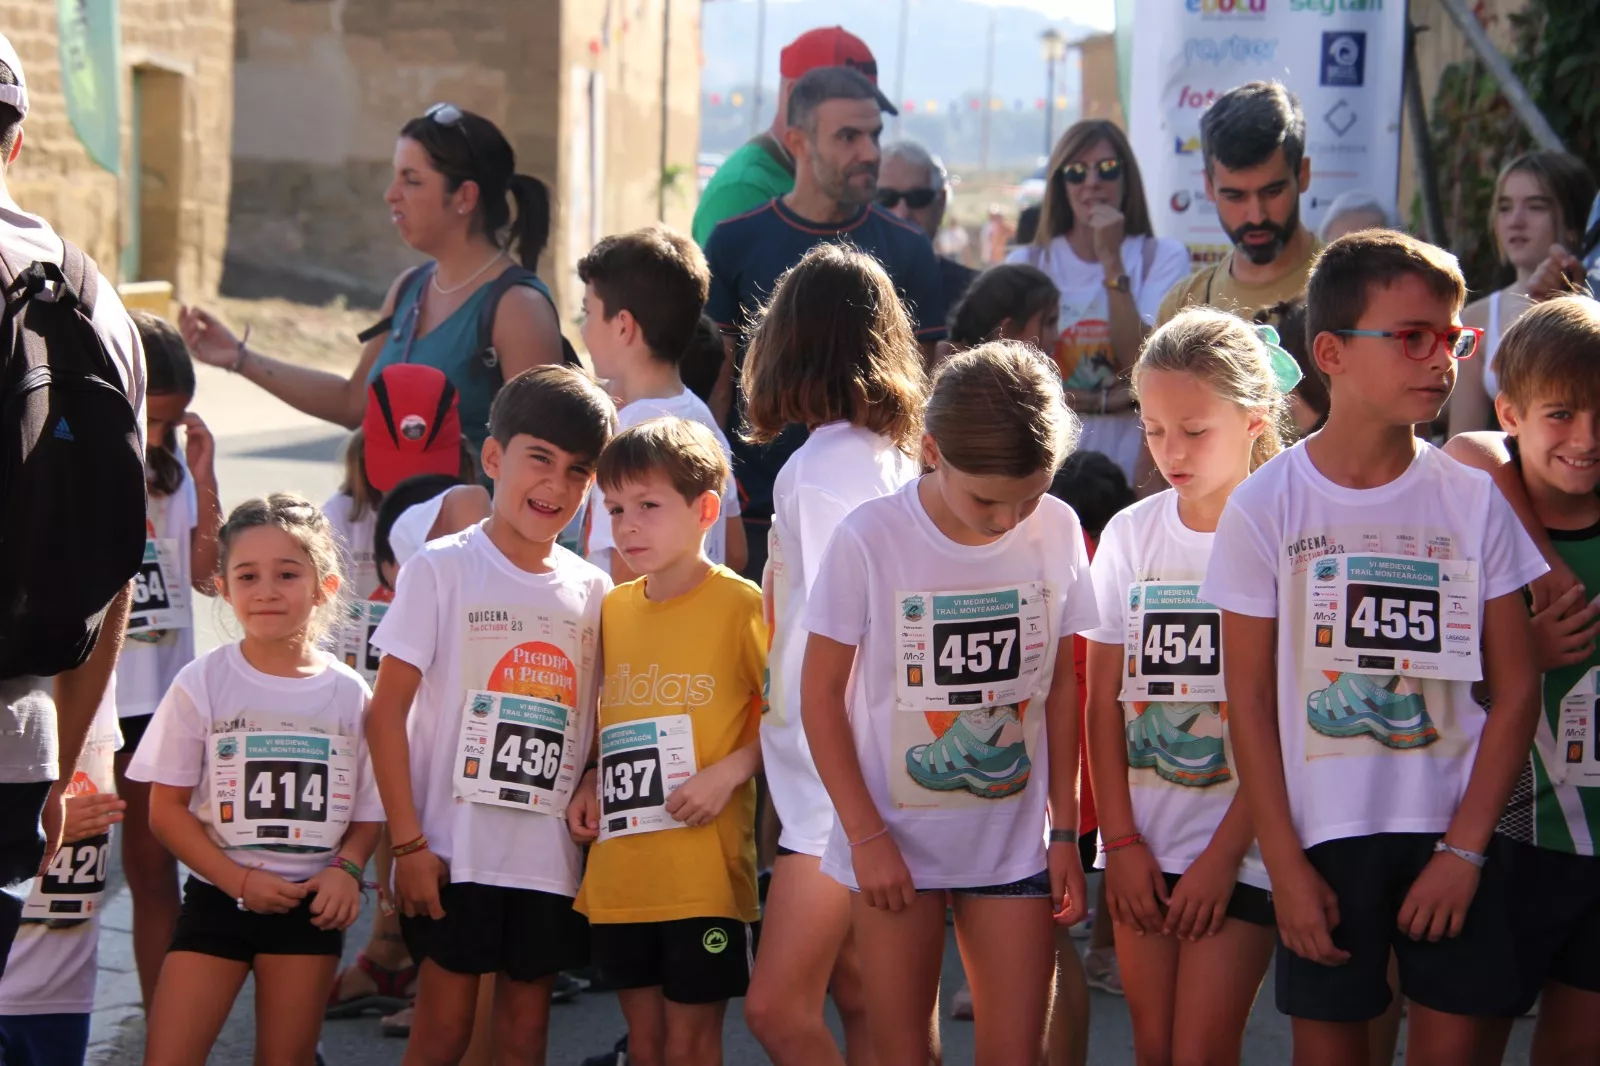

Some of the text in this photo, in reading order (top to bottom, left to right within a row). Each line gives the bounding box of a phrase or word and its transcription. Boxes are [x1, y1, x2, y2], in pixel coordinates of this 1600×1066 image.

[1350, 568, 1373, 576] TRAIL
[1379, 562, 1416, 571] MEDIEVAL
[133, 571, 164, 603] 64
[963, 597, 999, 606] MEDIEVAL
[468, 610, 508, 623] QUICENA
[511, 620, 523, 632] 23
[1352, 596, 1435, 642] 455
[939, 629, 1017, 674] 457
[1144, 624, 1215, 664] 454
[513, 647, 569, 671] PIEDRA
[520, 666, 573, 690] PIEDRA
[502, 709, 522, 717] TRAIL
[528, 705, 557, 716] MEDIEVAL
[497, 734, 561, 779] 436
[249, 771, 324, 811] 414
[604, 759, 656, 803] 437
[48, 845, 108, 884] 420
